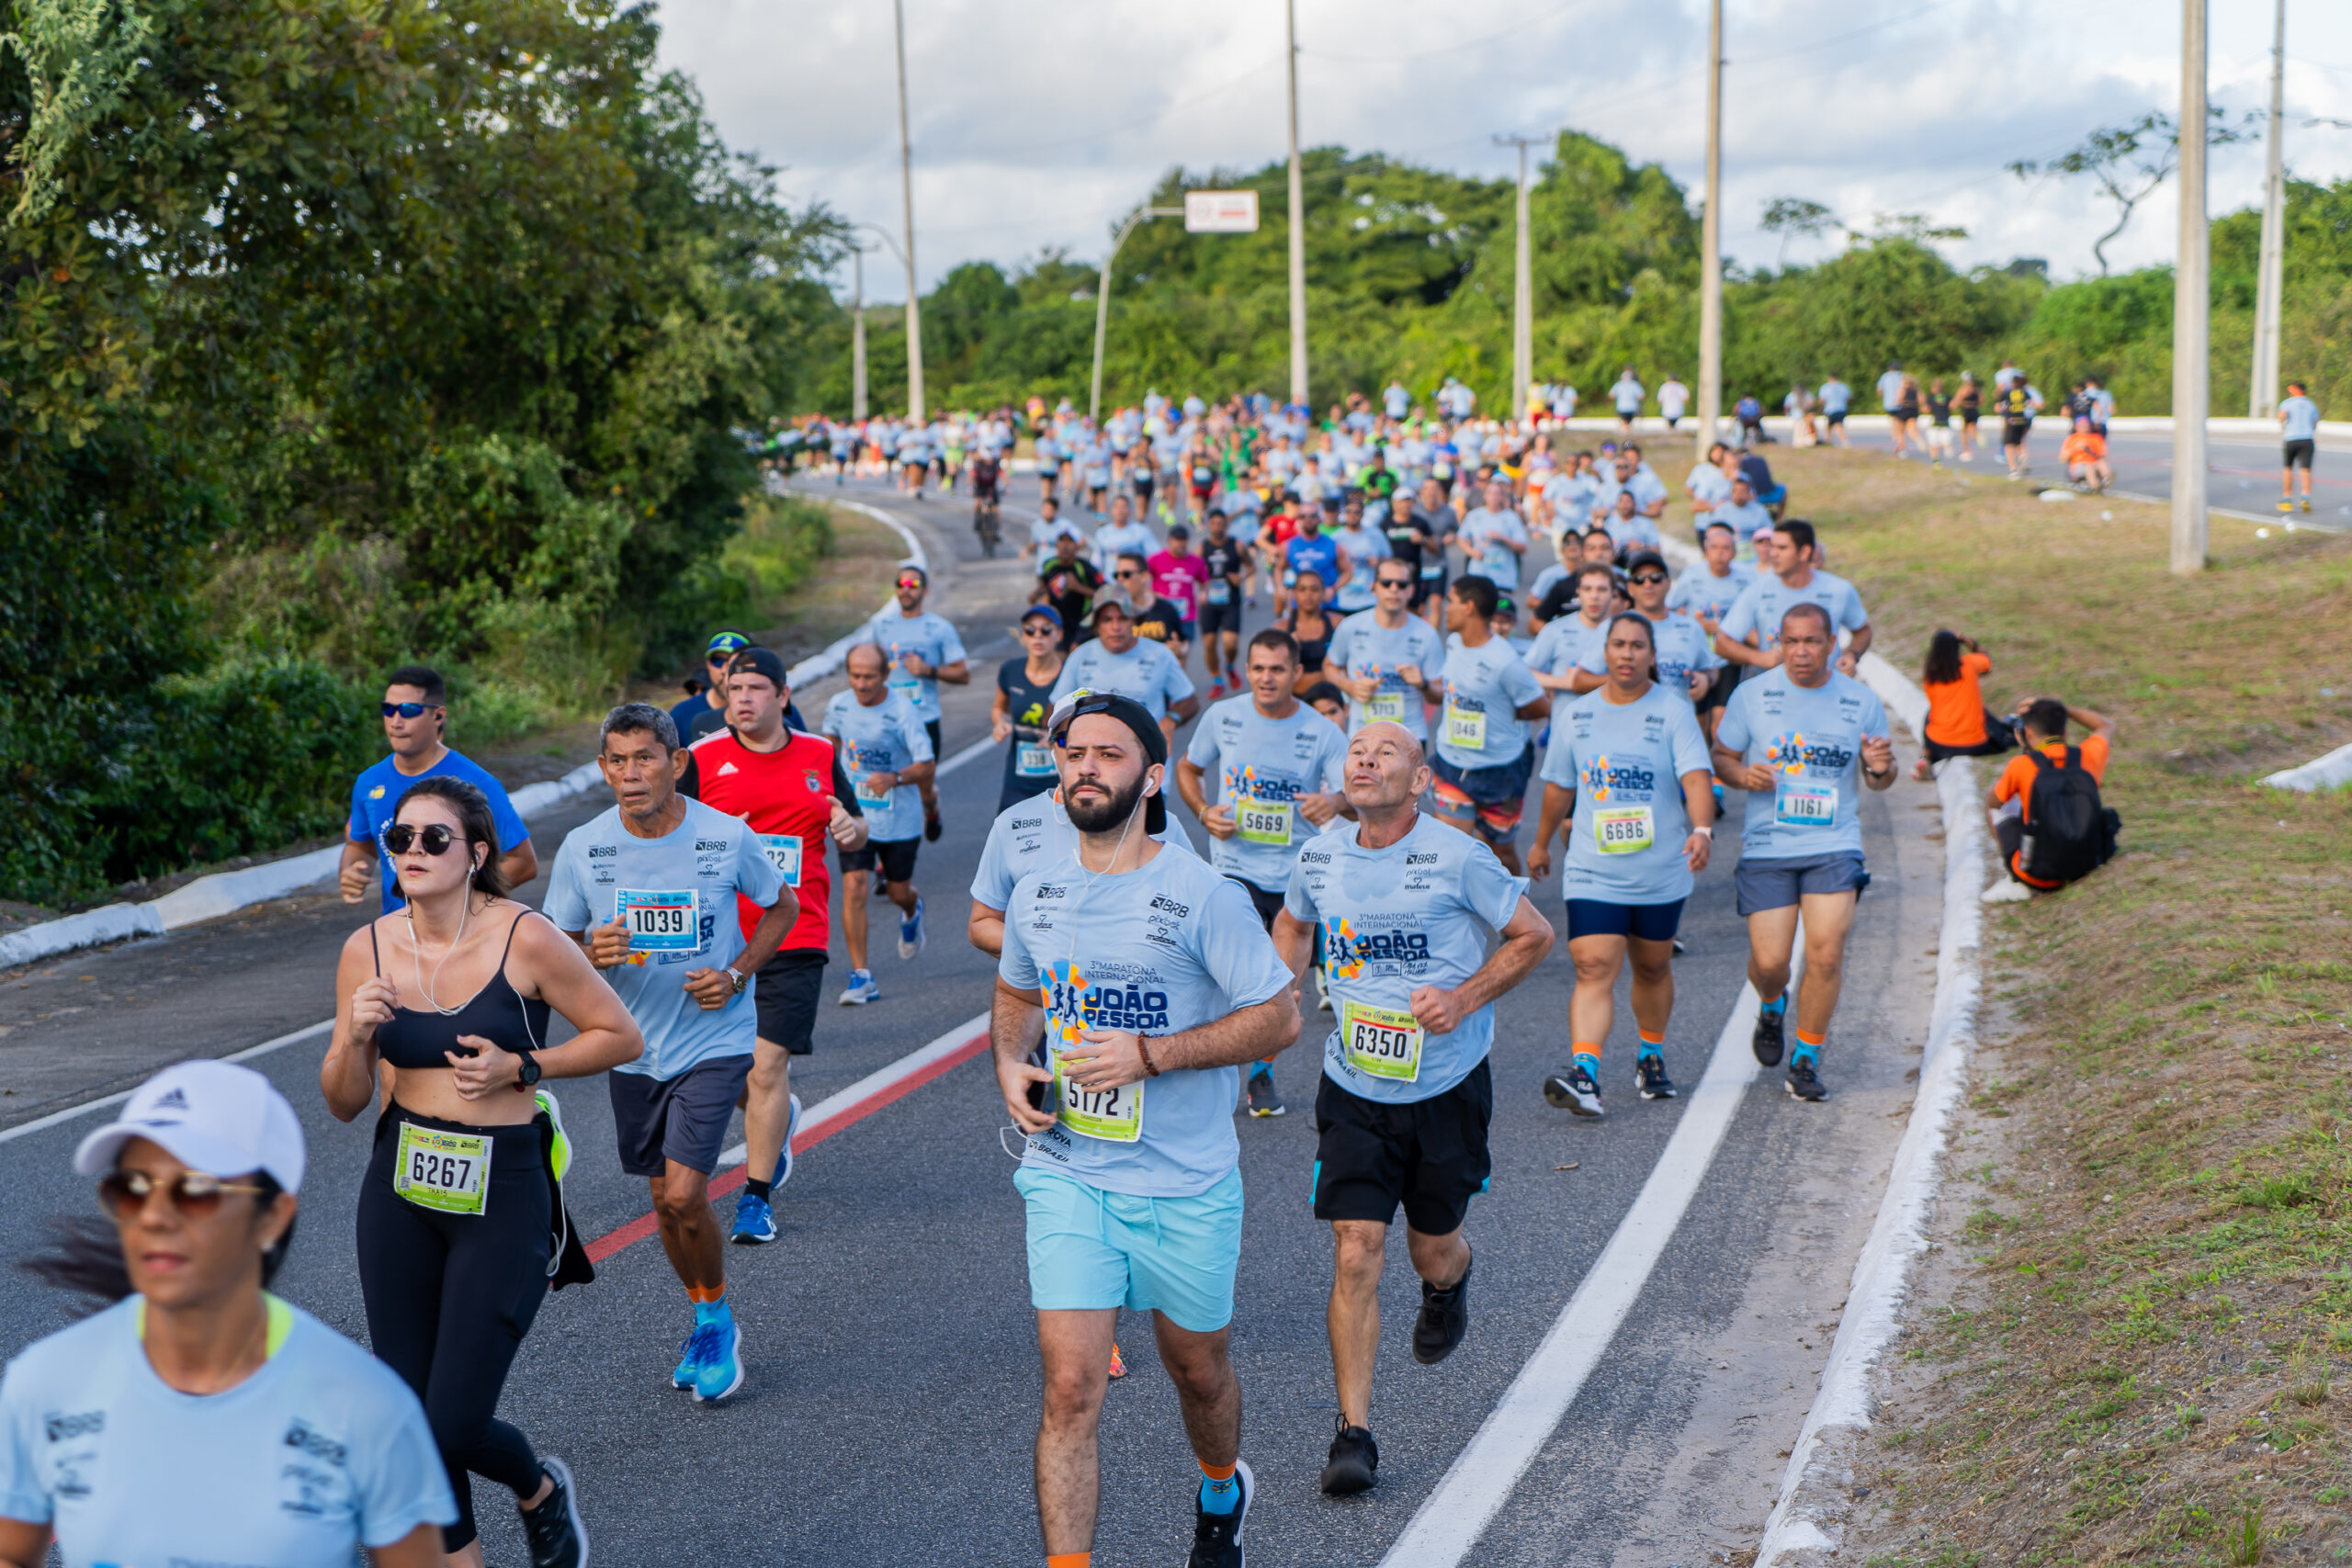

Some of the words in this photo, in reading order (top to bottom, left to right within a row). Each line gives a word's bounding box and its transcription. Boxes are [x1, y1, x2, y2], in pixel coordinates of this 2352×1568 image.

[1609, 766, 1654, 783] JOÃO
[1253, 779, 1301, 794] JOÃO
[1794, 797, 1822, 816] 1161
[1246, 812, 1283, 832] 5669
[1607, 821, 1644, 840] 6686
[599, 846, 616, 858] BRB
[707, 840, 727, 852] BRB
[1310, 852, 1331, 864] BRB
[1417, 853, 1439, 864] BRB
[1047, 886, 1067, 899] BRB
[1162, 897, 1189, 919] BRB
[634, 909, 683, 933] 1039
[1353, 919, 1426, 930] INTERNACIONAL
[1356, 930, 1429, 951] JOÃO
[1359, 948, 1431, 962] PESSOA
[1085, 970, 1167, 984] INTERNACIONAL
[1084, 984, 1168, 1012] JOÃO
[1082, 1009, 1169, 1029] PESSOA
[1355, 1024, 1407, 1059] 6350
[1046, 1128, 1071, 1147] ROVA
[413, 1152, 471, 1189] 6267
